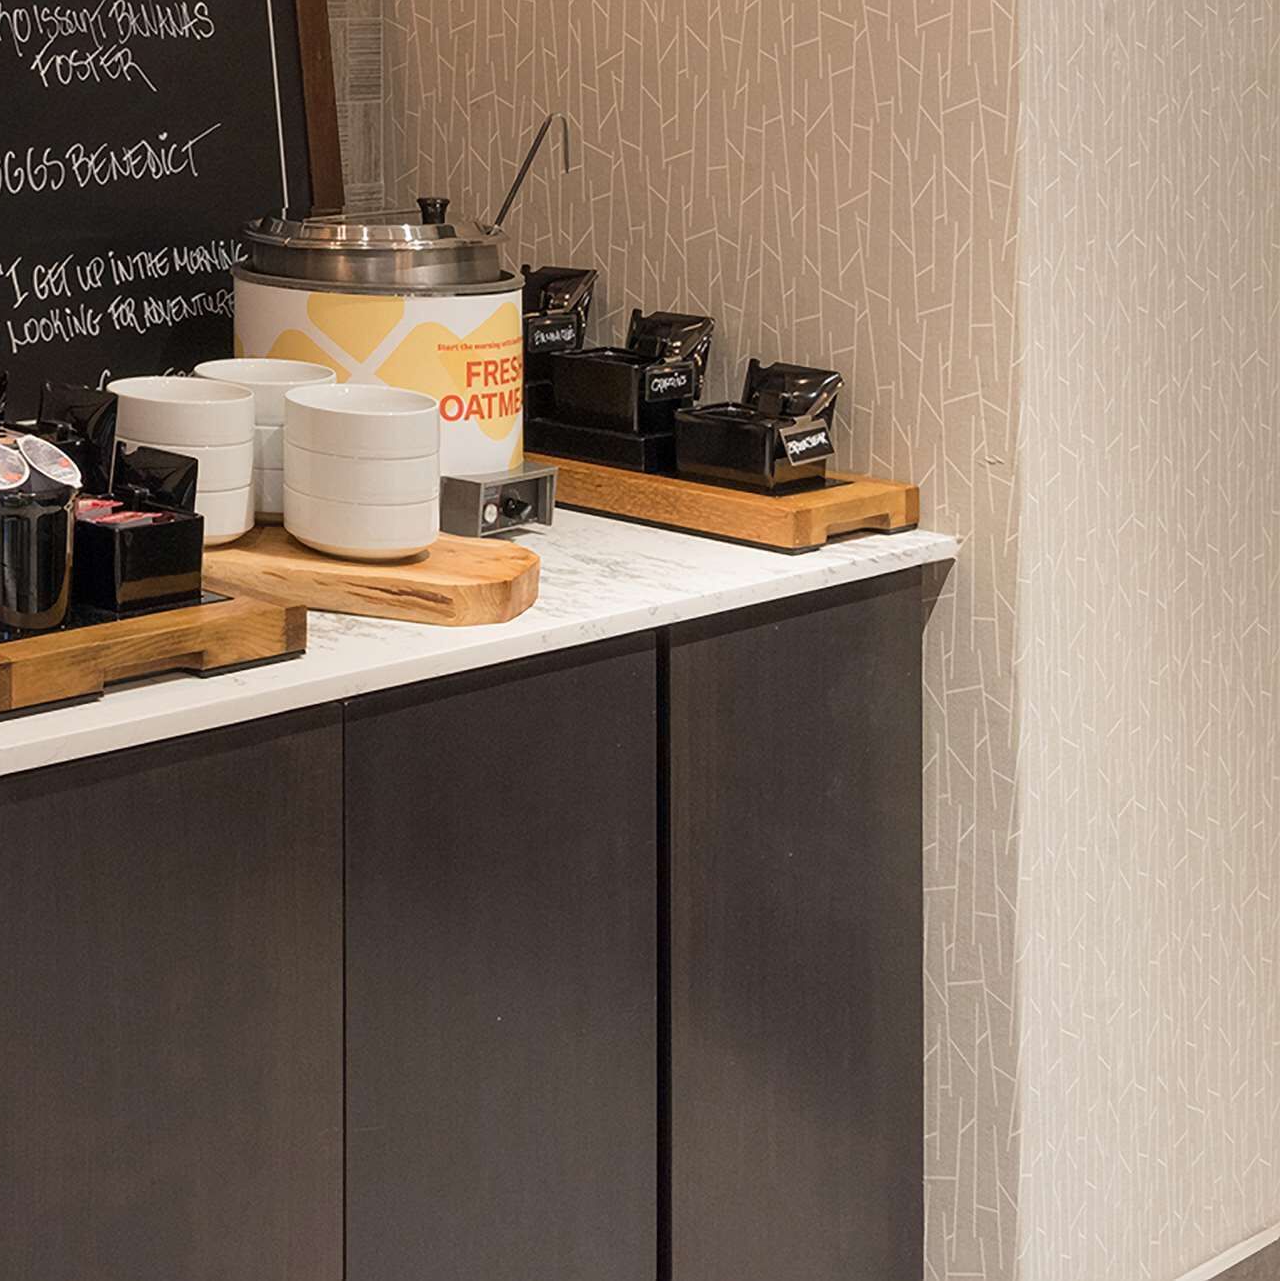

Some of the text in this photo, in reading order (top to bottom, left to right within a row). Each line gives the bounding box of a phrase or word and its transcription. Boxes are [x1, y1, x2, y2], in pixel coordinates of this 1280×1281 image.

[31, 44, 158, 93] FOSTER
[33, 254, 74, 300] GET
[77, 256, 105, 292] UP
[107, 295, 145, 335] FOR
[466, 356, 523, 387] FRES
[439, 387, 523, 422] OATME
